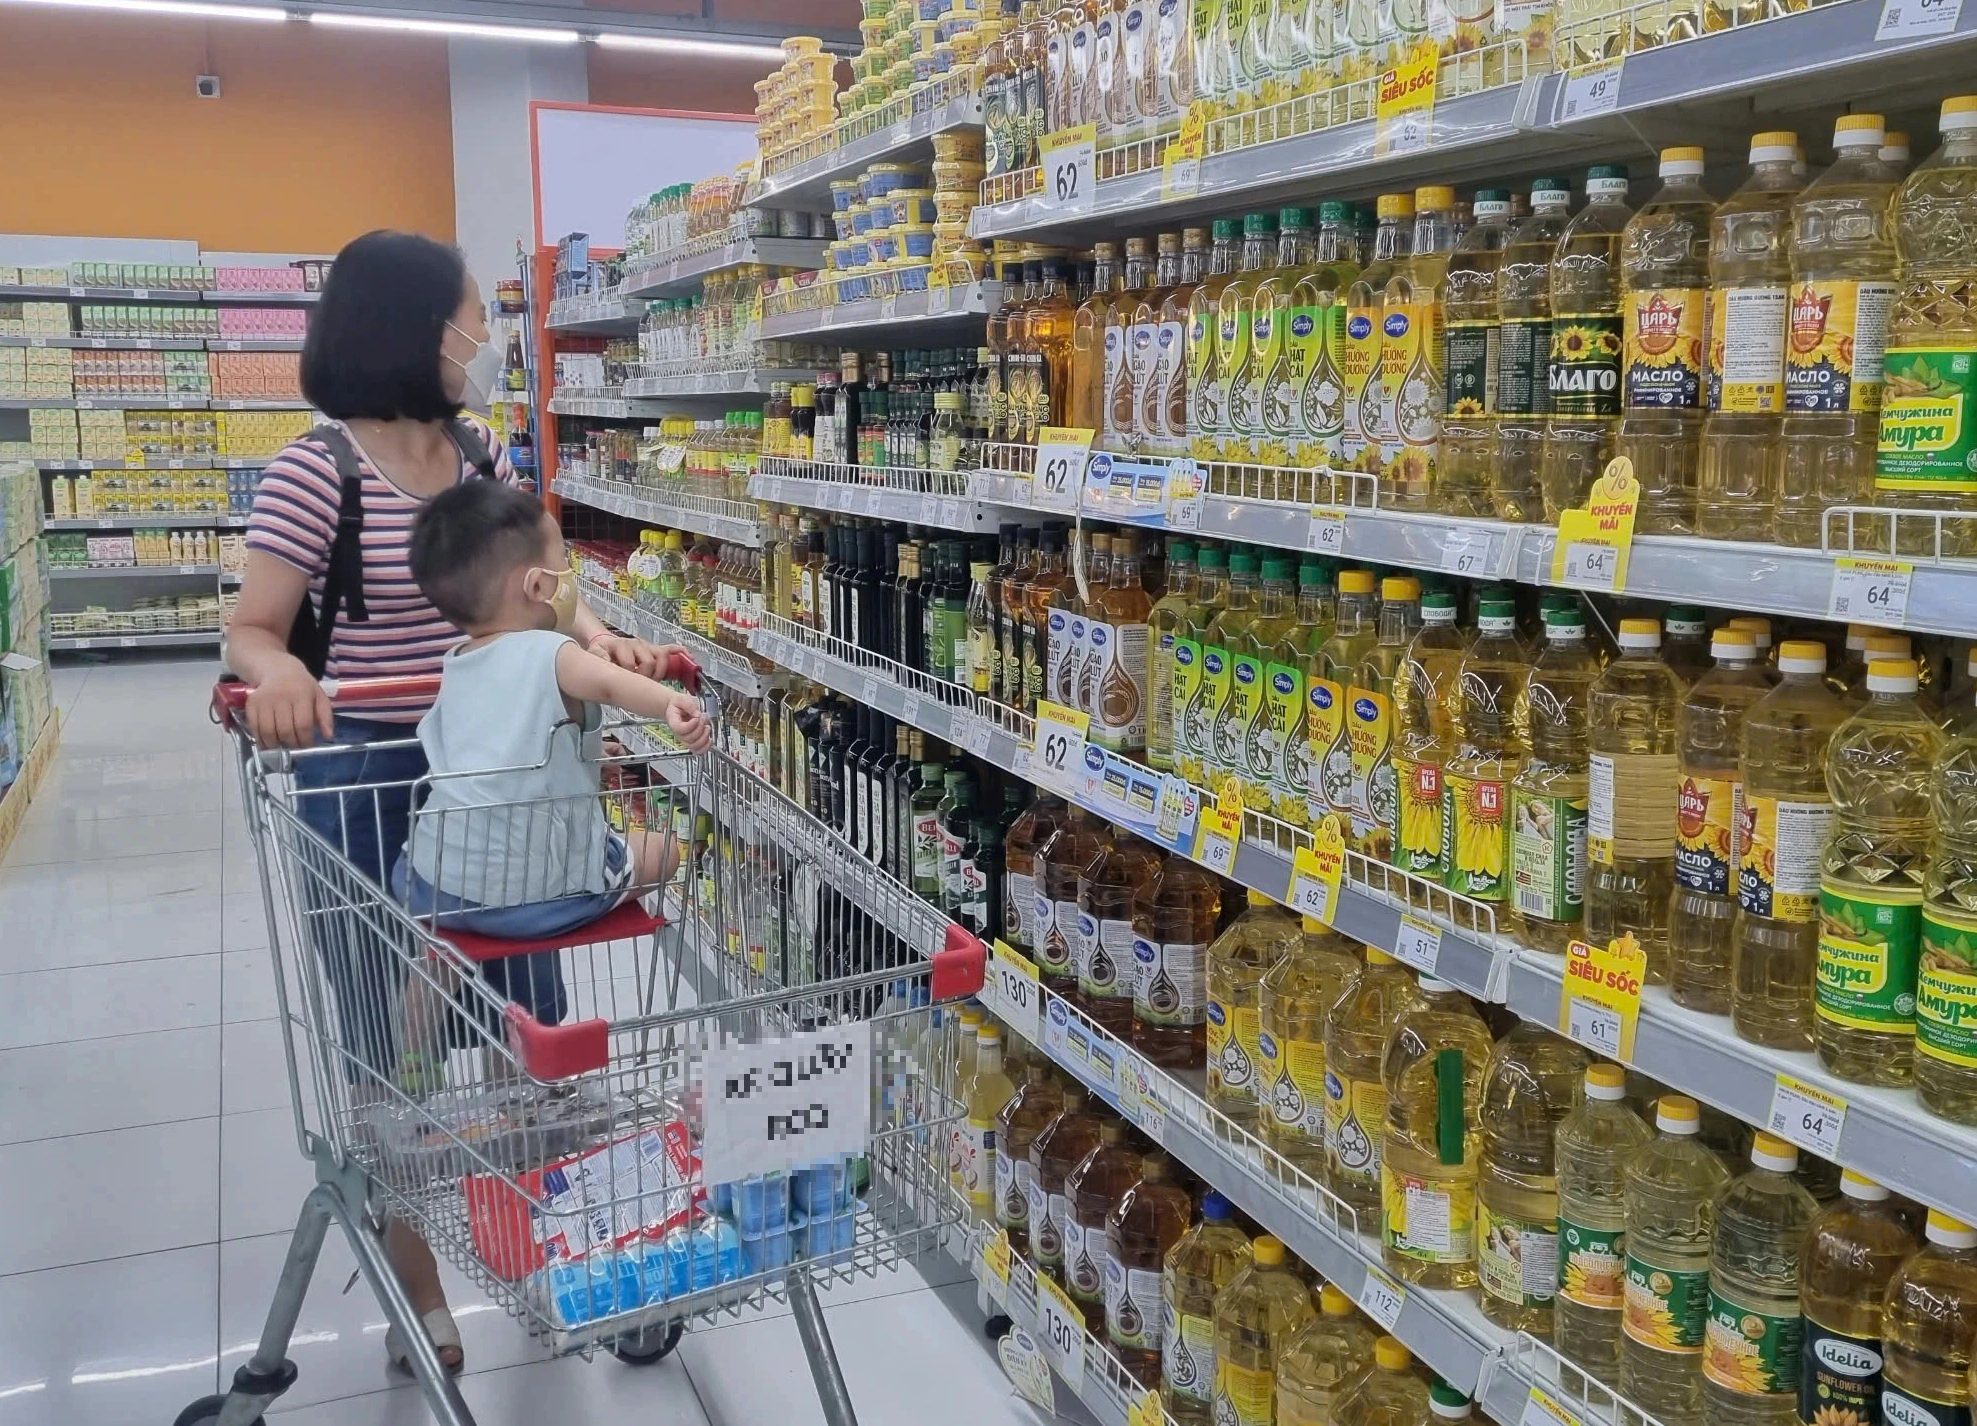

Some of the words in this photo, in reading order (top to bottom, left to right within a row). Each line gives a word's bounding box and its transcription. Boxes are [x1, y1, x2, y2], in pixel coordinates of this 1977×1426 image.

[1381, 80, 1406, 104] SIÊU
[1409, 66, 1434, 93] SỐC
[1589, 80, 1606, 98] 49
[1056, 163, 1079, 202] 62
[1293, 321, 1313, 332] Simply
[1350, 322, 1371, 333] Simply
[1386, 320, 1408, 331] Simply
[1641, 312, 1677, 327] ЦАРЬ
[1551, 366, 1616, 391] БЛАГО
[1632, 370, 1683, 382] МАСЛО
[1825, 397, 1831, 407] 1
[1046, 458, 1068, 494] 62
[1092, 461, 1111, 475] Simply
[1182, 506, 1190, 519] 69
[1591, 504, 1633, 517] KHUYẾN
[1322, 528, 1333, 542] 62
[1458, 555, 1473, 571] 67
[1587, 553, 1603, 570] 64
[1868, 586, 1889, 605] 64
[1236, 667, 1254, 681] Simply
[1274, 677, 1293, 691] Simply
[1312, 690, 1332, 706] Simply
[1356, 702, 1377, 718] Simply
[1045, 734, 1067, 770] 62
[1086, 750, 1103, 767] Simply
[1217, 808, 1240, 823] KHUYẾN
[1213, 846, 1223, 860] 69
[1314, 850, 1341, 864] KHUYẾN
[1306, 890, 1318, 906] 62
[1416, 939, 1428, 955] 51
[1573, 945, 1587, 957] GIÁ
[1568, 960, 1603, 984] SIÊU
[1606, 970, 1639, 996] SỐC
[1001, 970, 1027, 1008] 130
[1591, 1020, 1605, 1038] 61
[1802, 1113, 1823, 1135] 64
[1375, 1290, 1391, 1312] 112
[1046, 1308, 1071, 1354] 130
[1822, 1345, 1873, 1370] Idelia
[1816, 1371, 1863, 1392] SUNFLOWER
